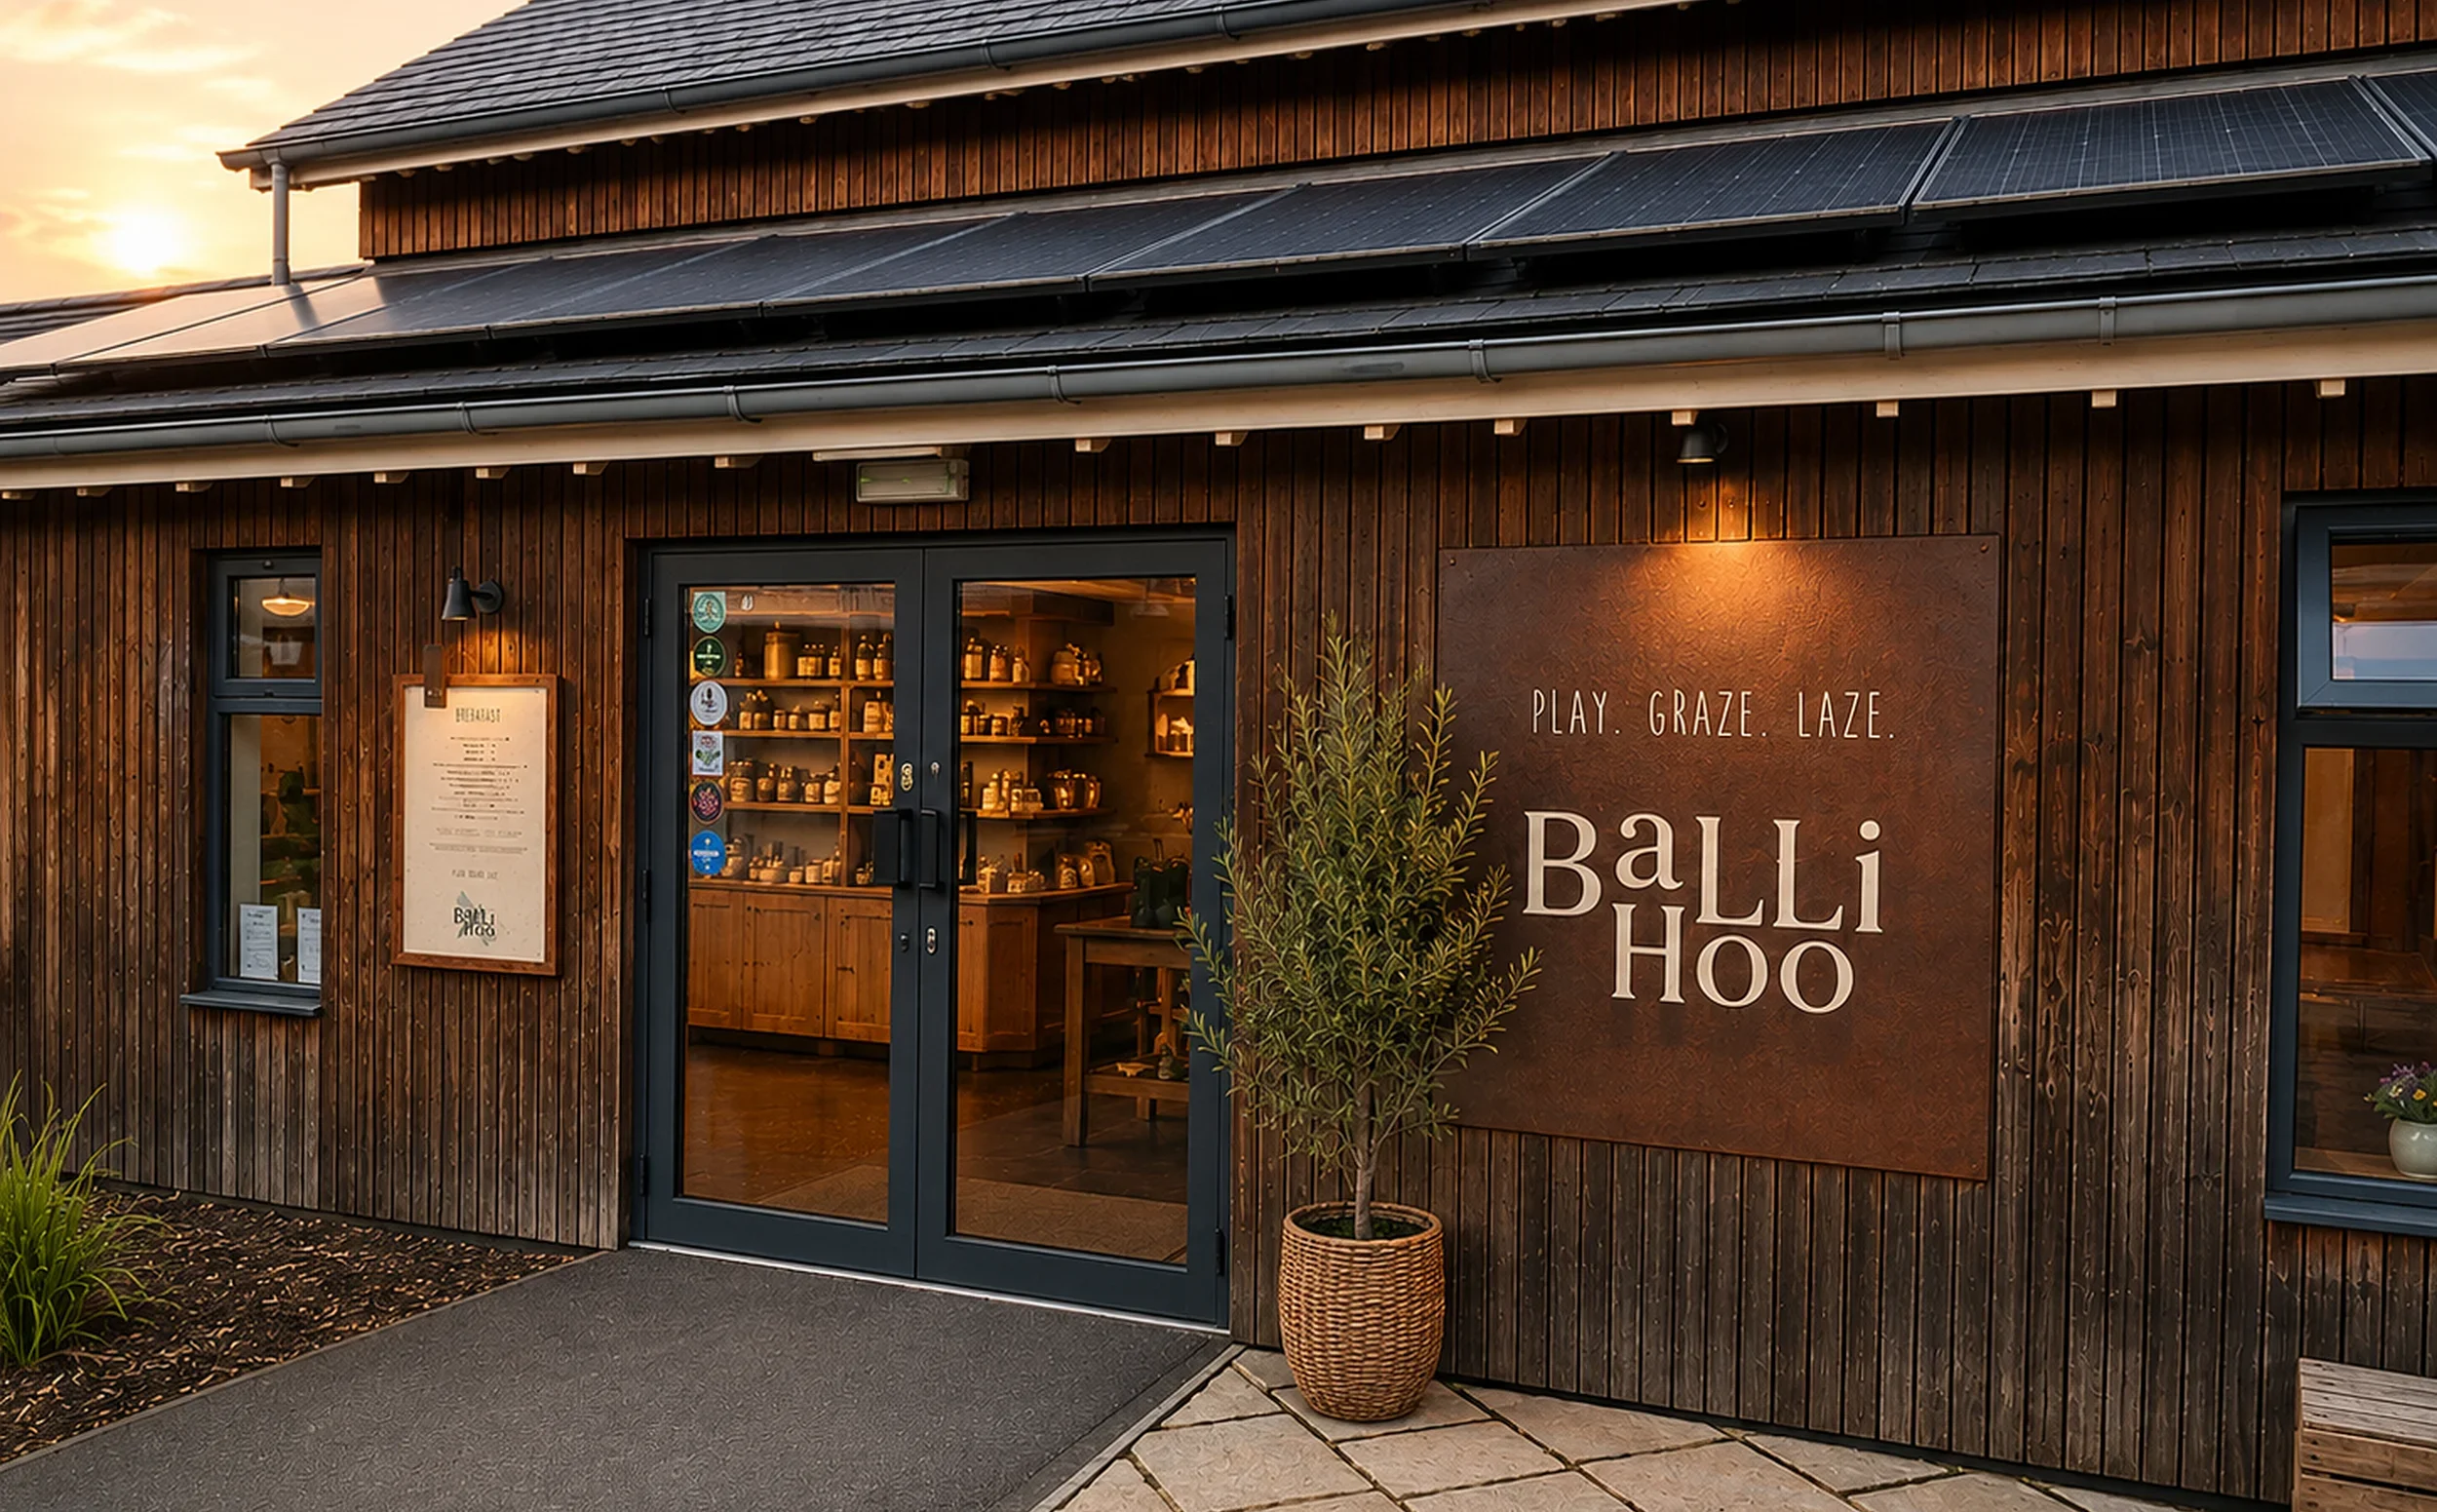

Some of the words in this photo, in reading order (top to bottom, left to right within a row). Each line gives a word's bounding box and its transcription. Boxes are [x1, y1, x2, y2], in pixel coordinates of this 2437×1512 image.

[1533, 689, 1620, 735] PLAY.
[1649, 689, 1766, 737] GRAZE.
[1798, 690, 1894, 740] LAZE.
